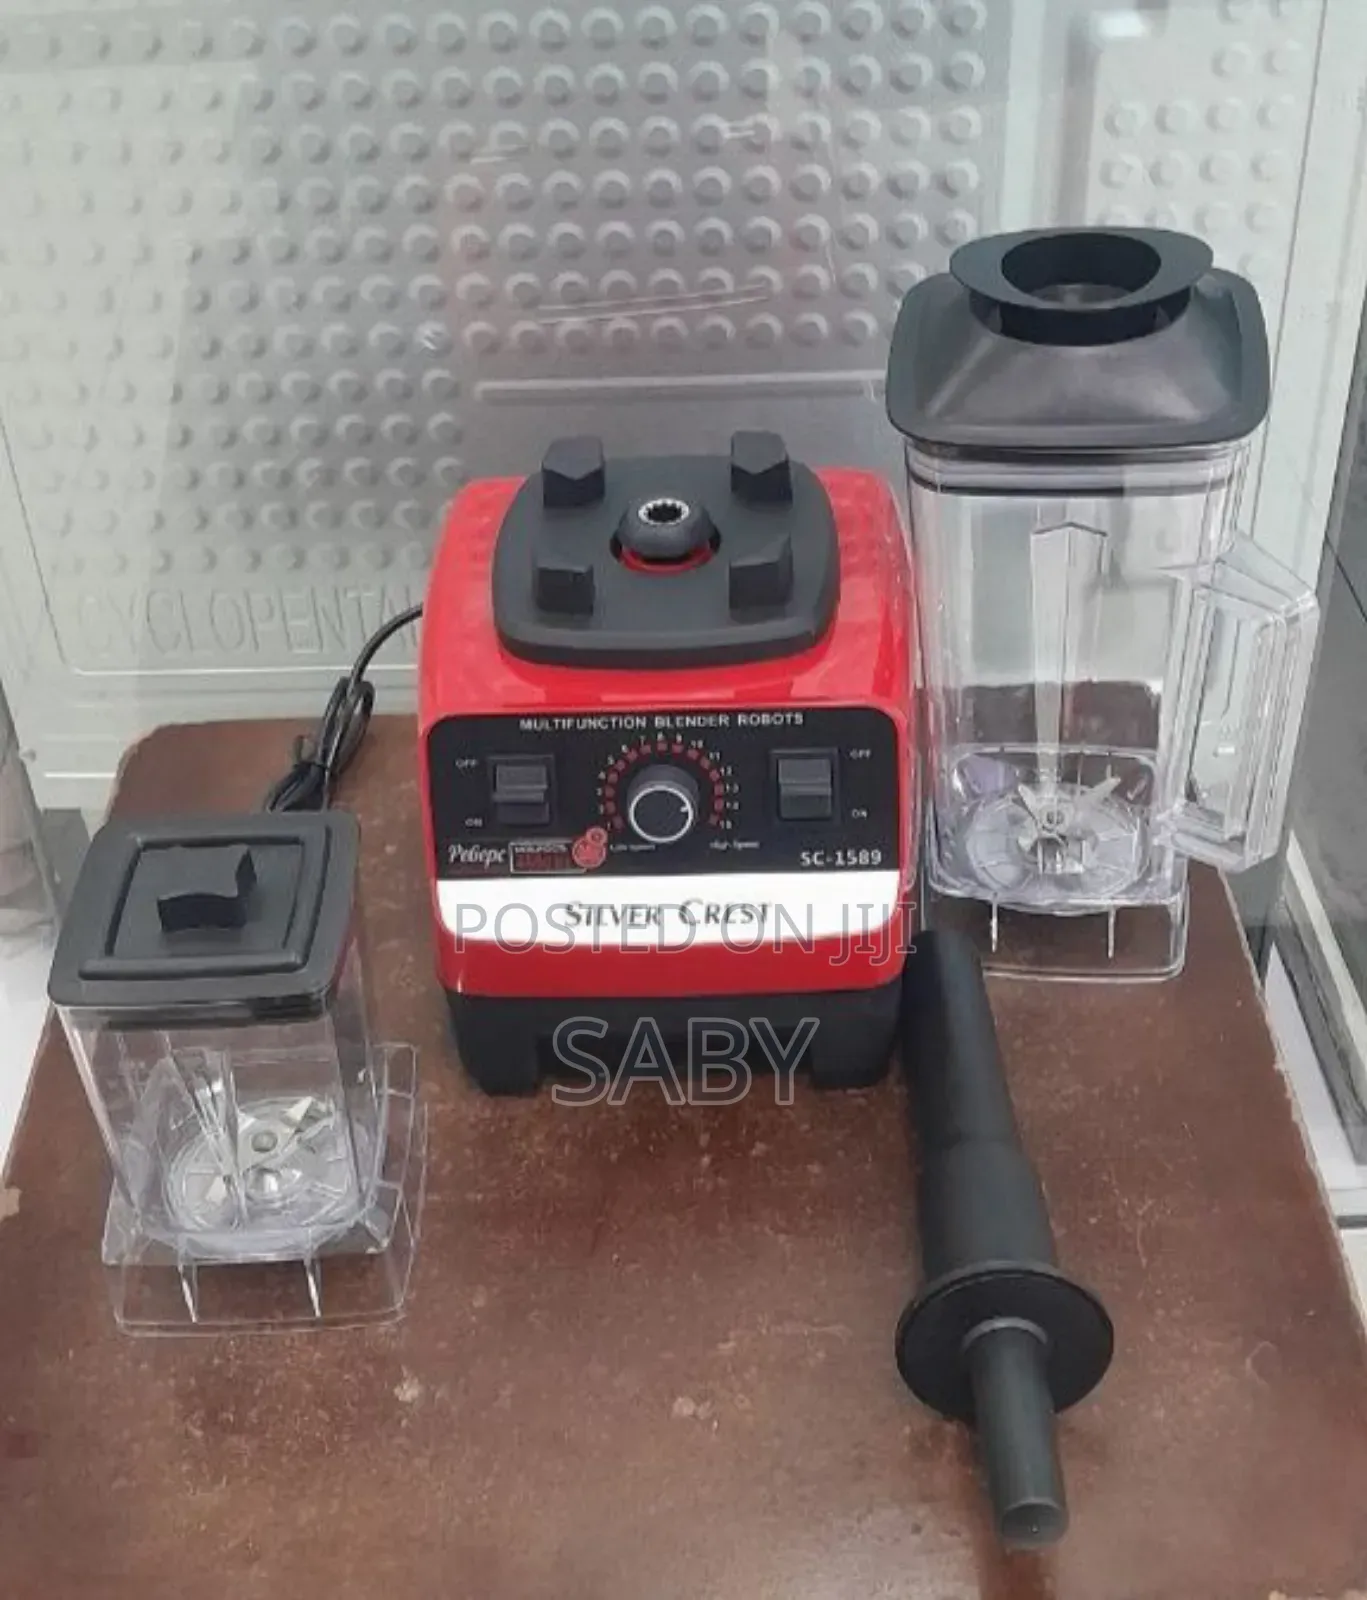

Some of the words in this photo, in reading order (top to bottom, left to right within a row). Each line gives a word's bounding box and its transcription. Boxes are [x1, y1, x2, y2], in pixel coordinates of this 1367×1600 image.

[519, 716, 647, 732] MULTIFUNCTION
[654, 713, 730, 728] BLENDER
[738, 711, 804, 726] ROBOTS
[849, 749, 872, 760] OFF
[455, 757, 479, 769] OFF
[851, 808, 868, 819] ON
[465, 817, 483, 828] ON
[800, 850, 882, 867] SC-1589
[565, 901, 662, 927] SILVER
[678, 898, 772, 926] CREST
